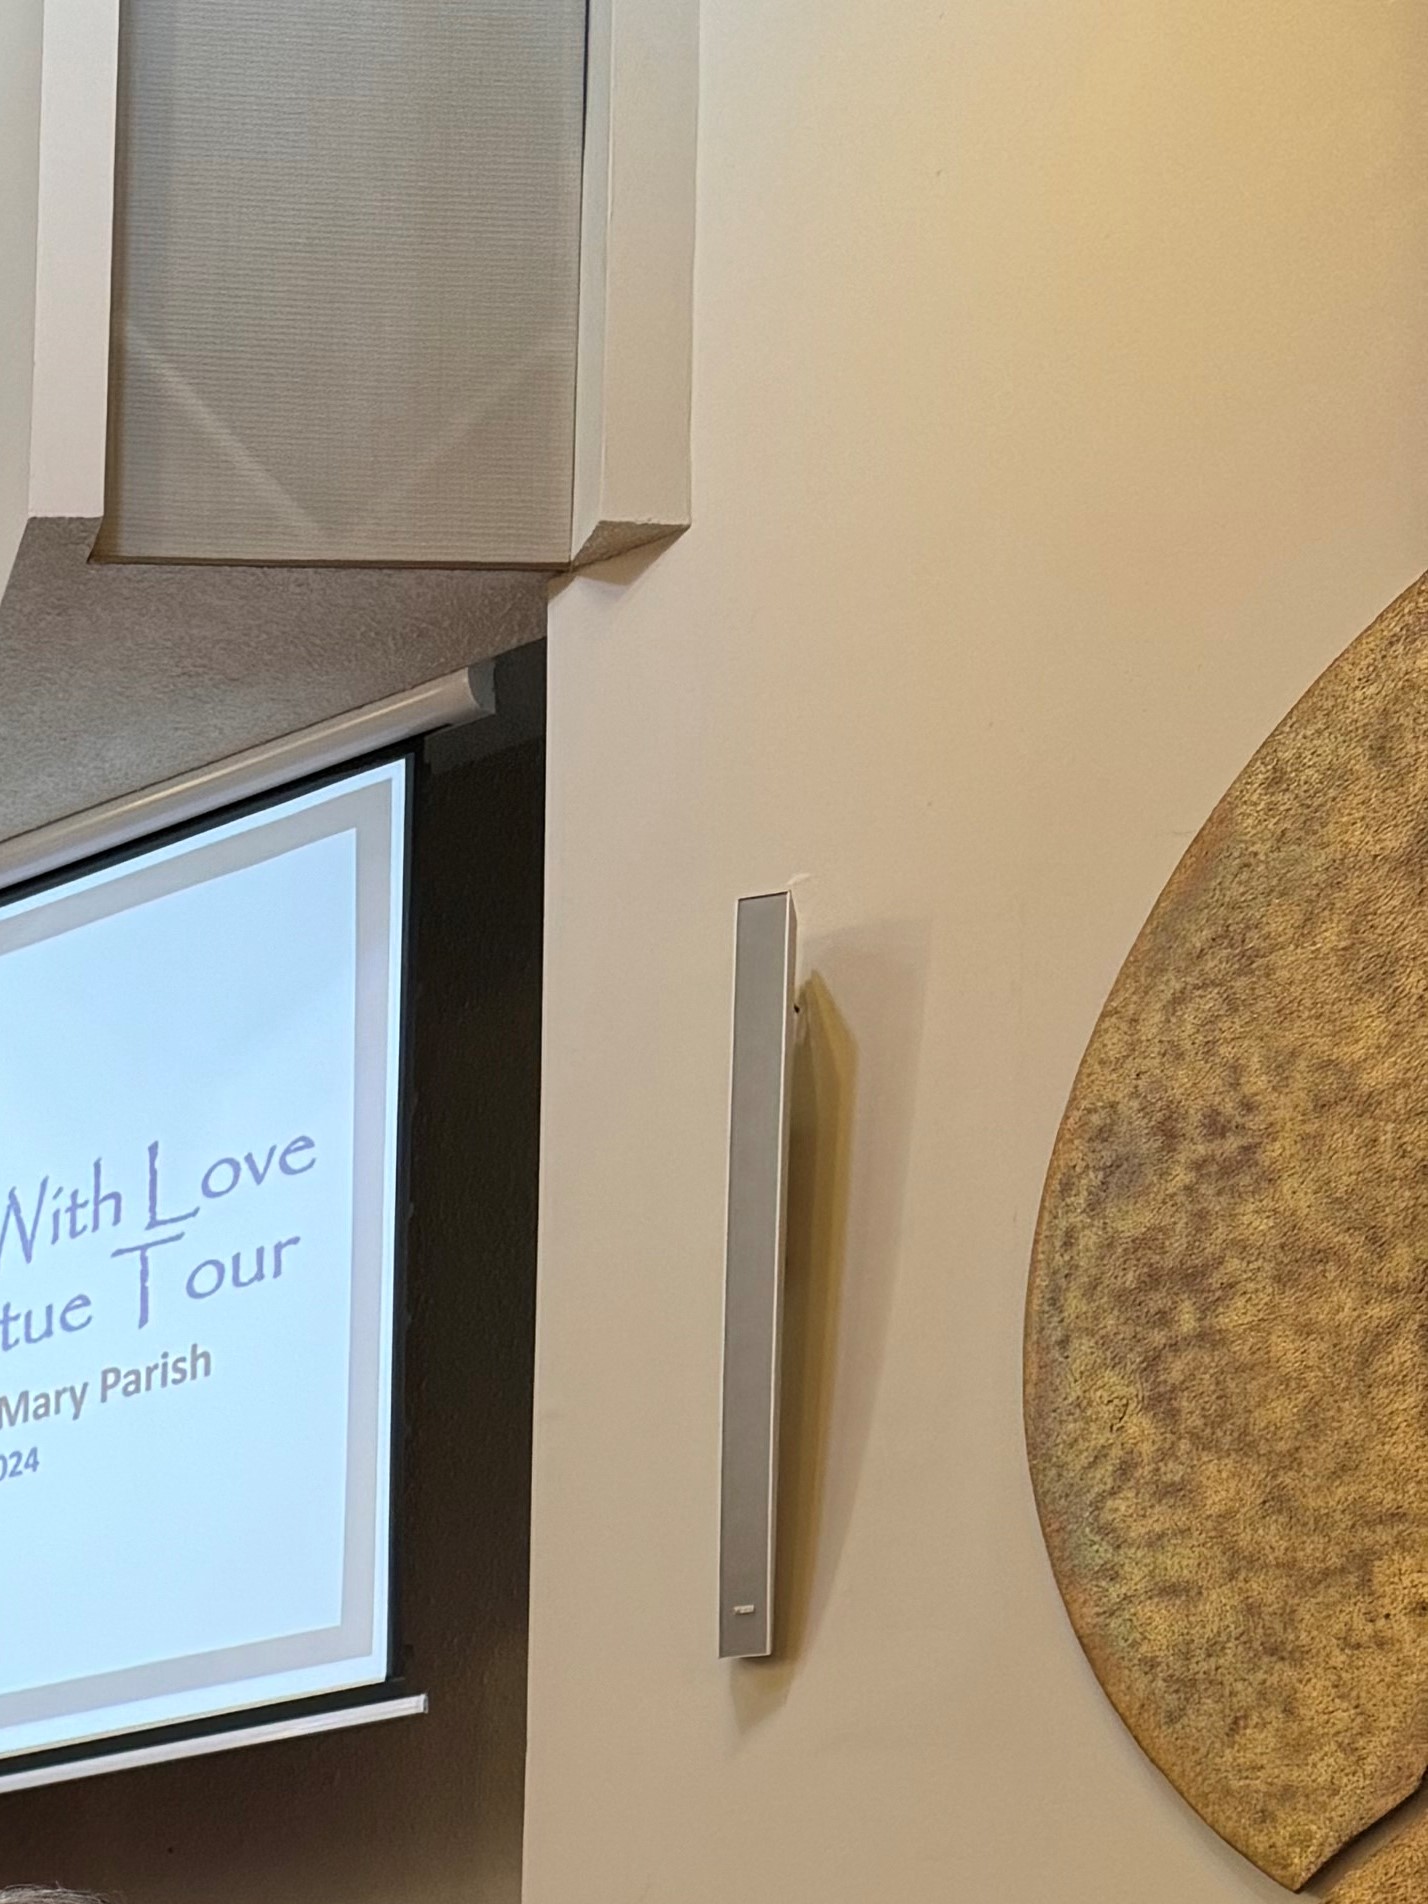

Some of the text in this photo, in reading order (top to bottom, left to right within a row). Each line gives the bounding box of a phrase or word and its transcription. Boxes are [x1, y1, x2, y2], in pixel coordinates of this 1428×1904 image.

[144, 1134, 317, 1231] Love
[110, 1231, 301, 1331] Tour
[100, 1343, 212, 1404] Parish
